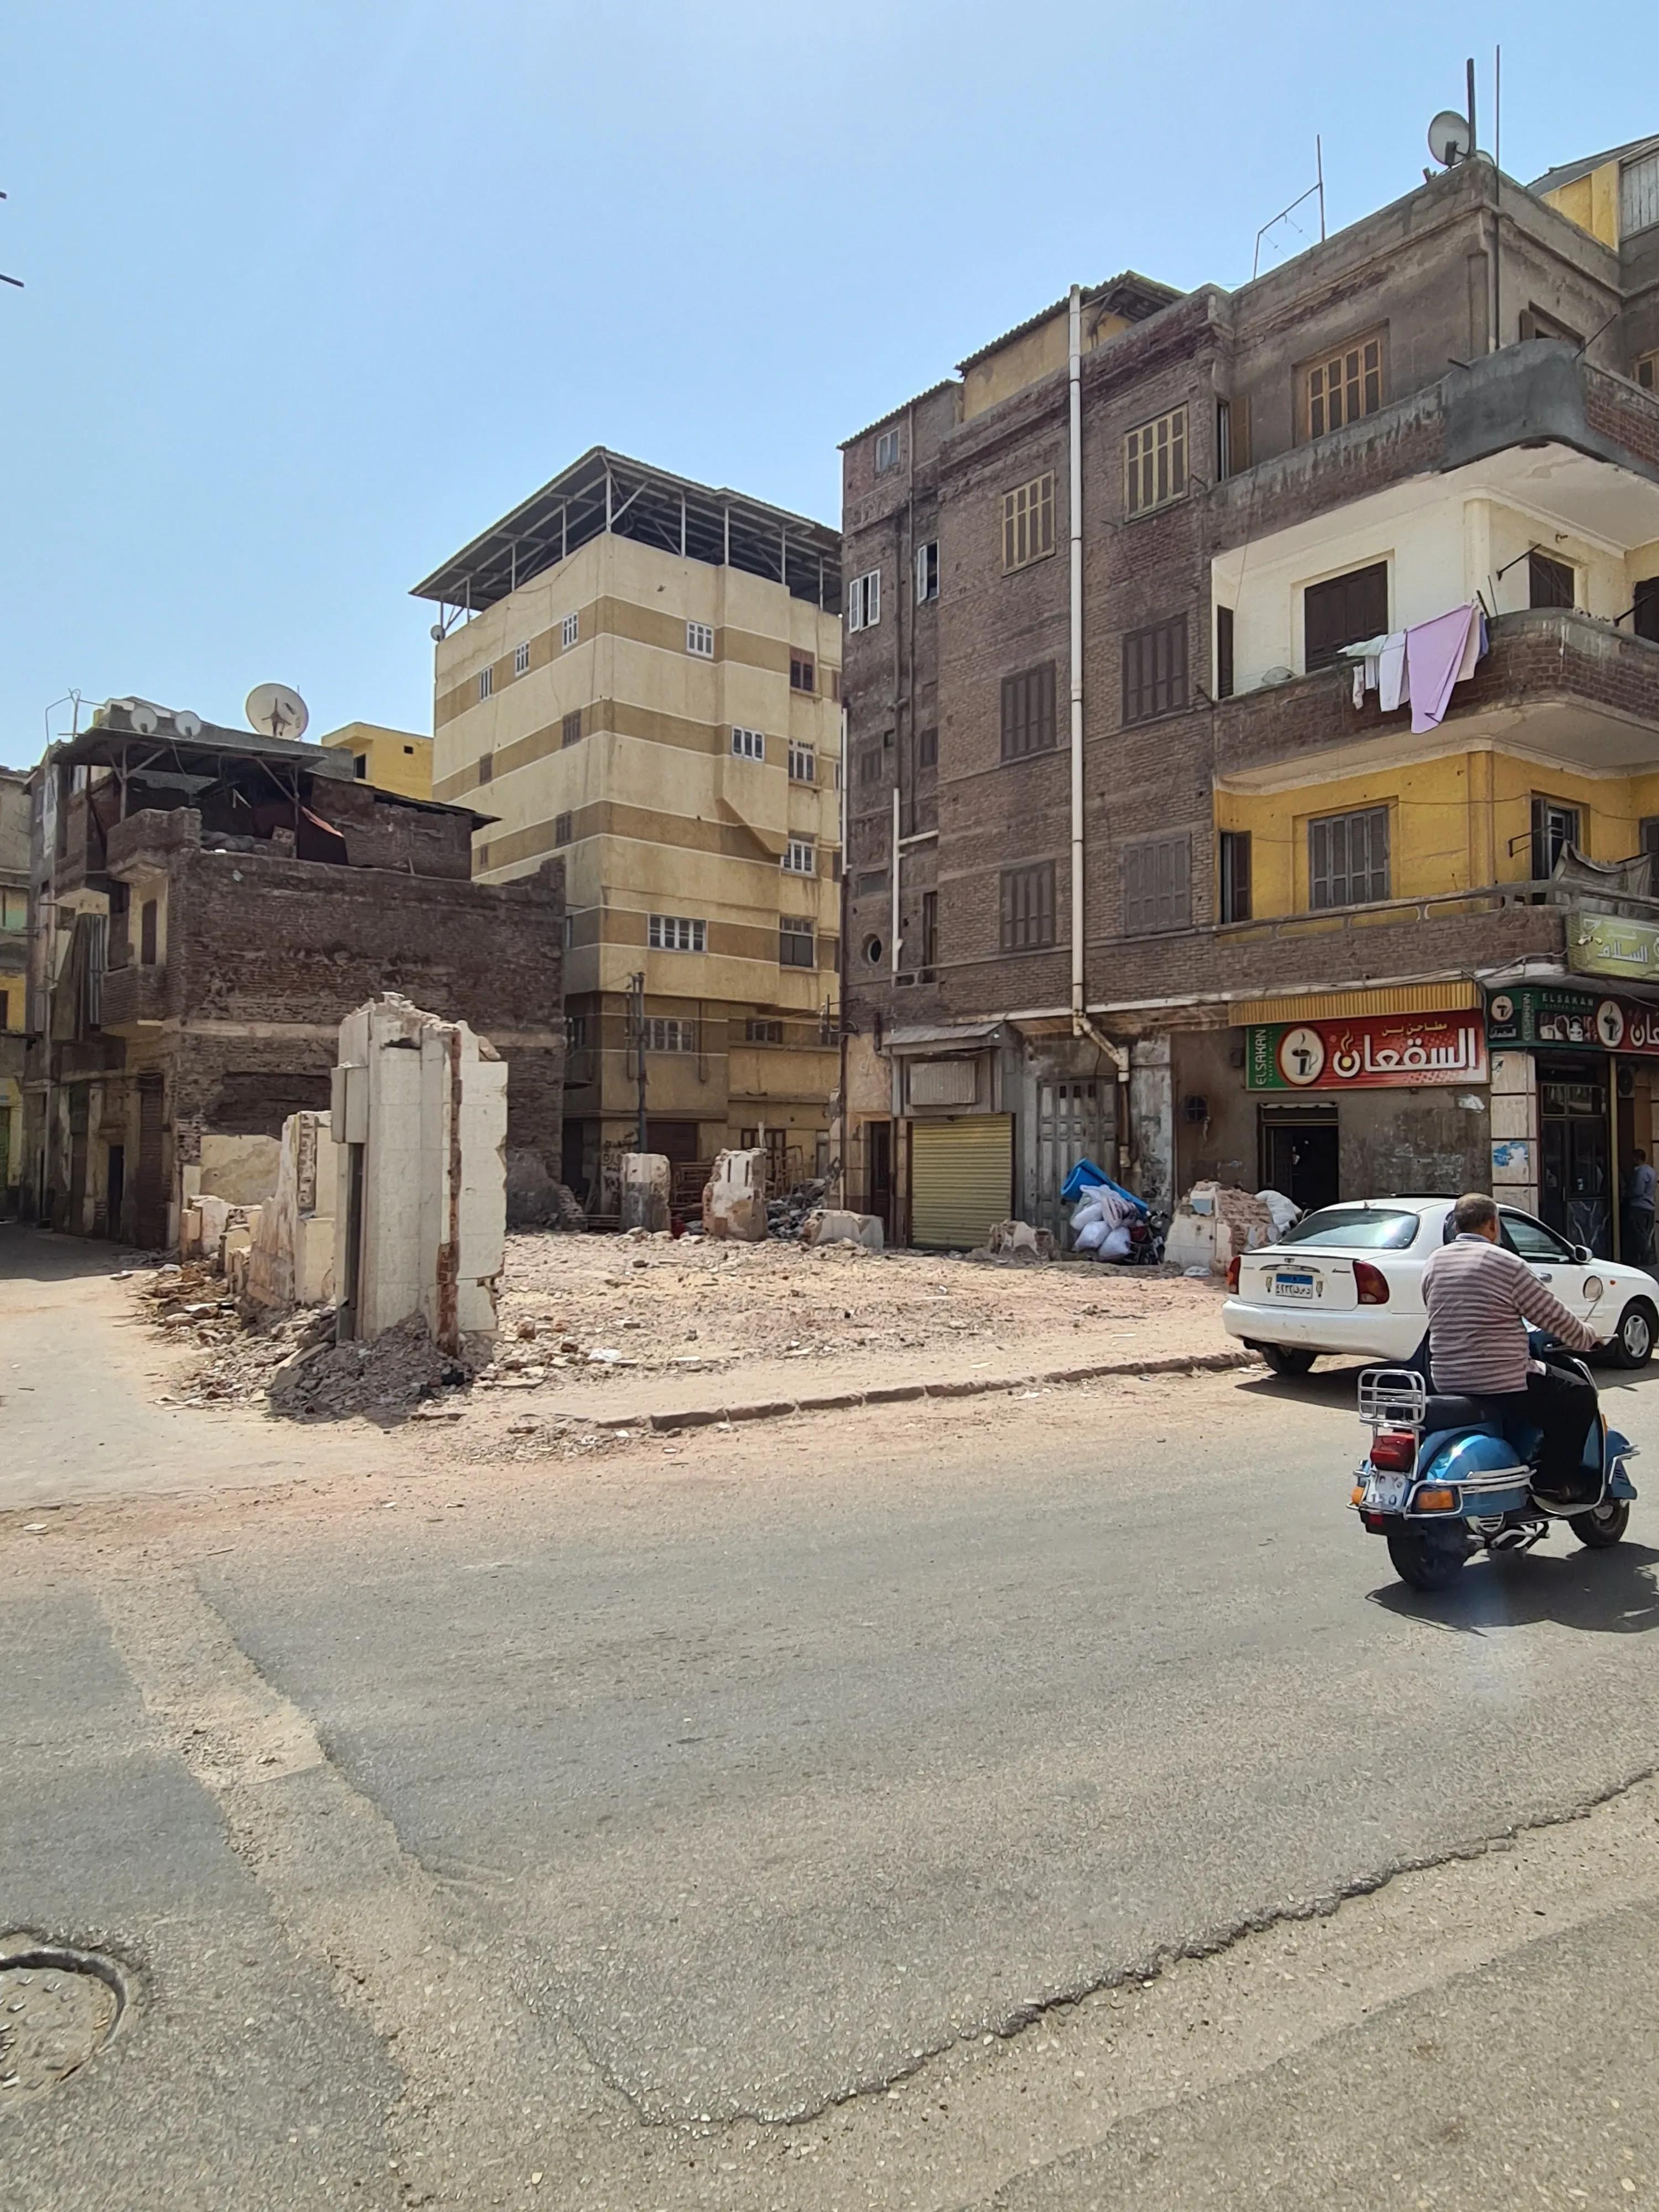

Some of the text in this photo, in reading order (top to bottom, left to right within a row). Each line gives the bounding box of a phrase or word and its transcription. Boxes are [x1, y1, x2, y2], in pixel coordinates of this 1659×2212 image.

[1542, 993, 1593, 1006] ELSAKAN
[1406, 1021, 1447, 1035] مطاحن
[1255, 1029, 1267, 1085] ELSAKAN
[1332, 1027, 1476, 1078] السقعان
